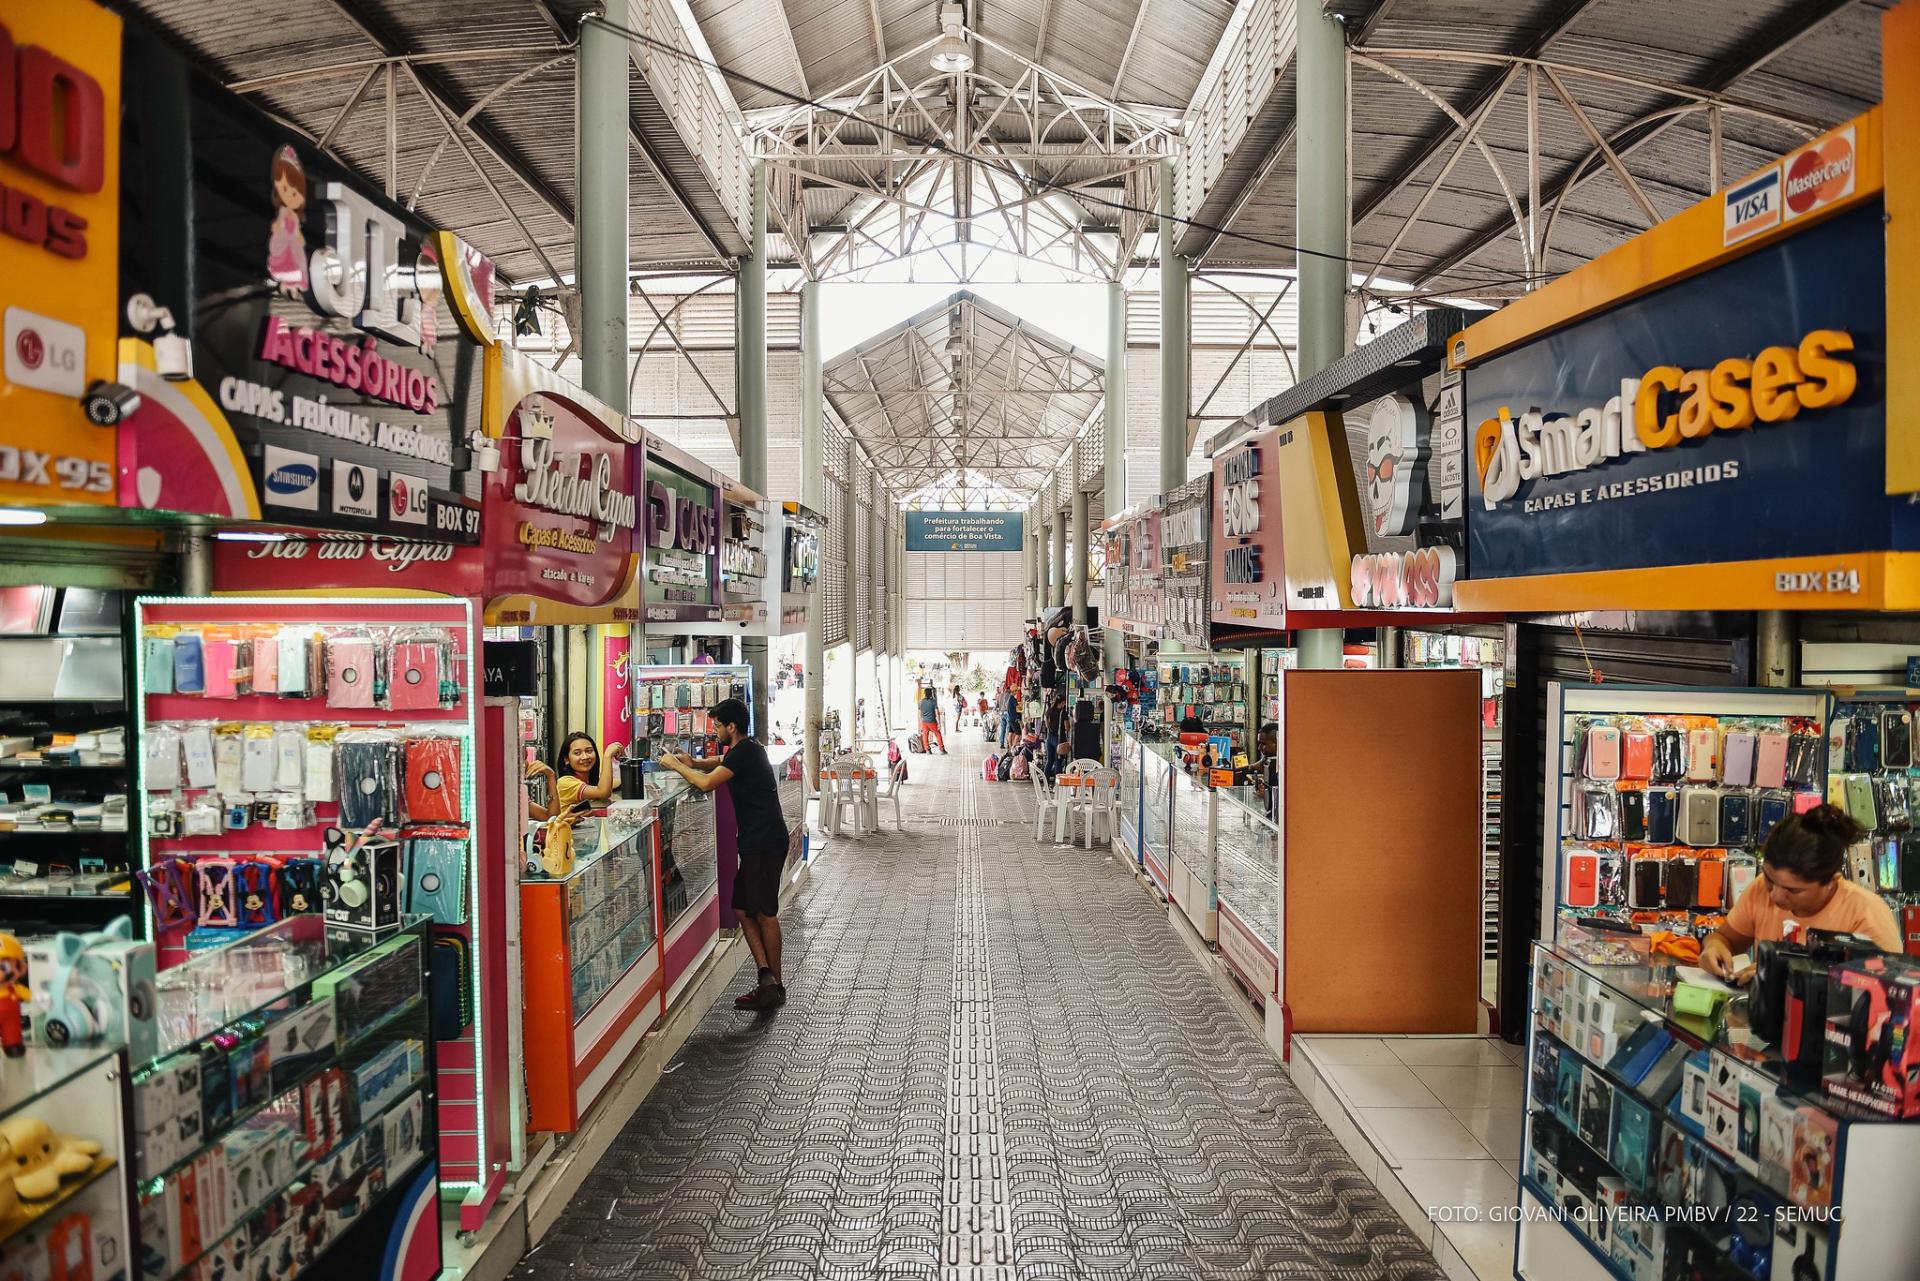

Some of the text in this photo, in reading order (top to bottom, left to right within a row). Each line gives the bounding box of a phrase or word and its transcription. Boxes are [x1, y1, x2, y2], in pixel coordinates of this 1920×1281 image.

[1787, 153, 1852, 197] MasterCard
[0, 183, 88, 261] OS
[1735, 197, 1769, 225] VISA
[51, 345, 76, 371] LG
[261, 314, 438, 414] ACESSÓRIOS
[55, 457, 112, 492] 95
[272, 471, 312, 486] SAMSUNG
[1442, 472, 1460, 482] LACOSTE
[1524, 460, 1739, 513] CAPAS E ACESSORIOS
[339, 505, 372, 516] MOTOROLA
[410, 488, 426, 513] LG
[594, 453, 635, 543] Capas
[437, 505, 480, 534] BOX 97
[678, 497, 716, 555] CASE
[923, 517, 1004, 525] Prefeitura trabalhando
[952, 524, 987, 532] fortalecer
[520, 520, 550, 552] Capas
[552, 529, 558, 545] e
[924, 532, 1004, 540] comércio de Boa Vista.
[1775, 568, 1861, 594] BOX 84
[1828, 1083, 1848, 1098] GAME
[1848, 1089, 1896, 1115] HEADPHONES
